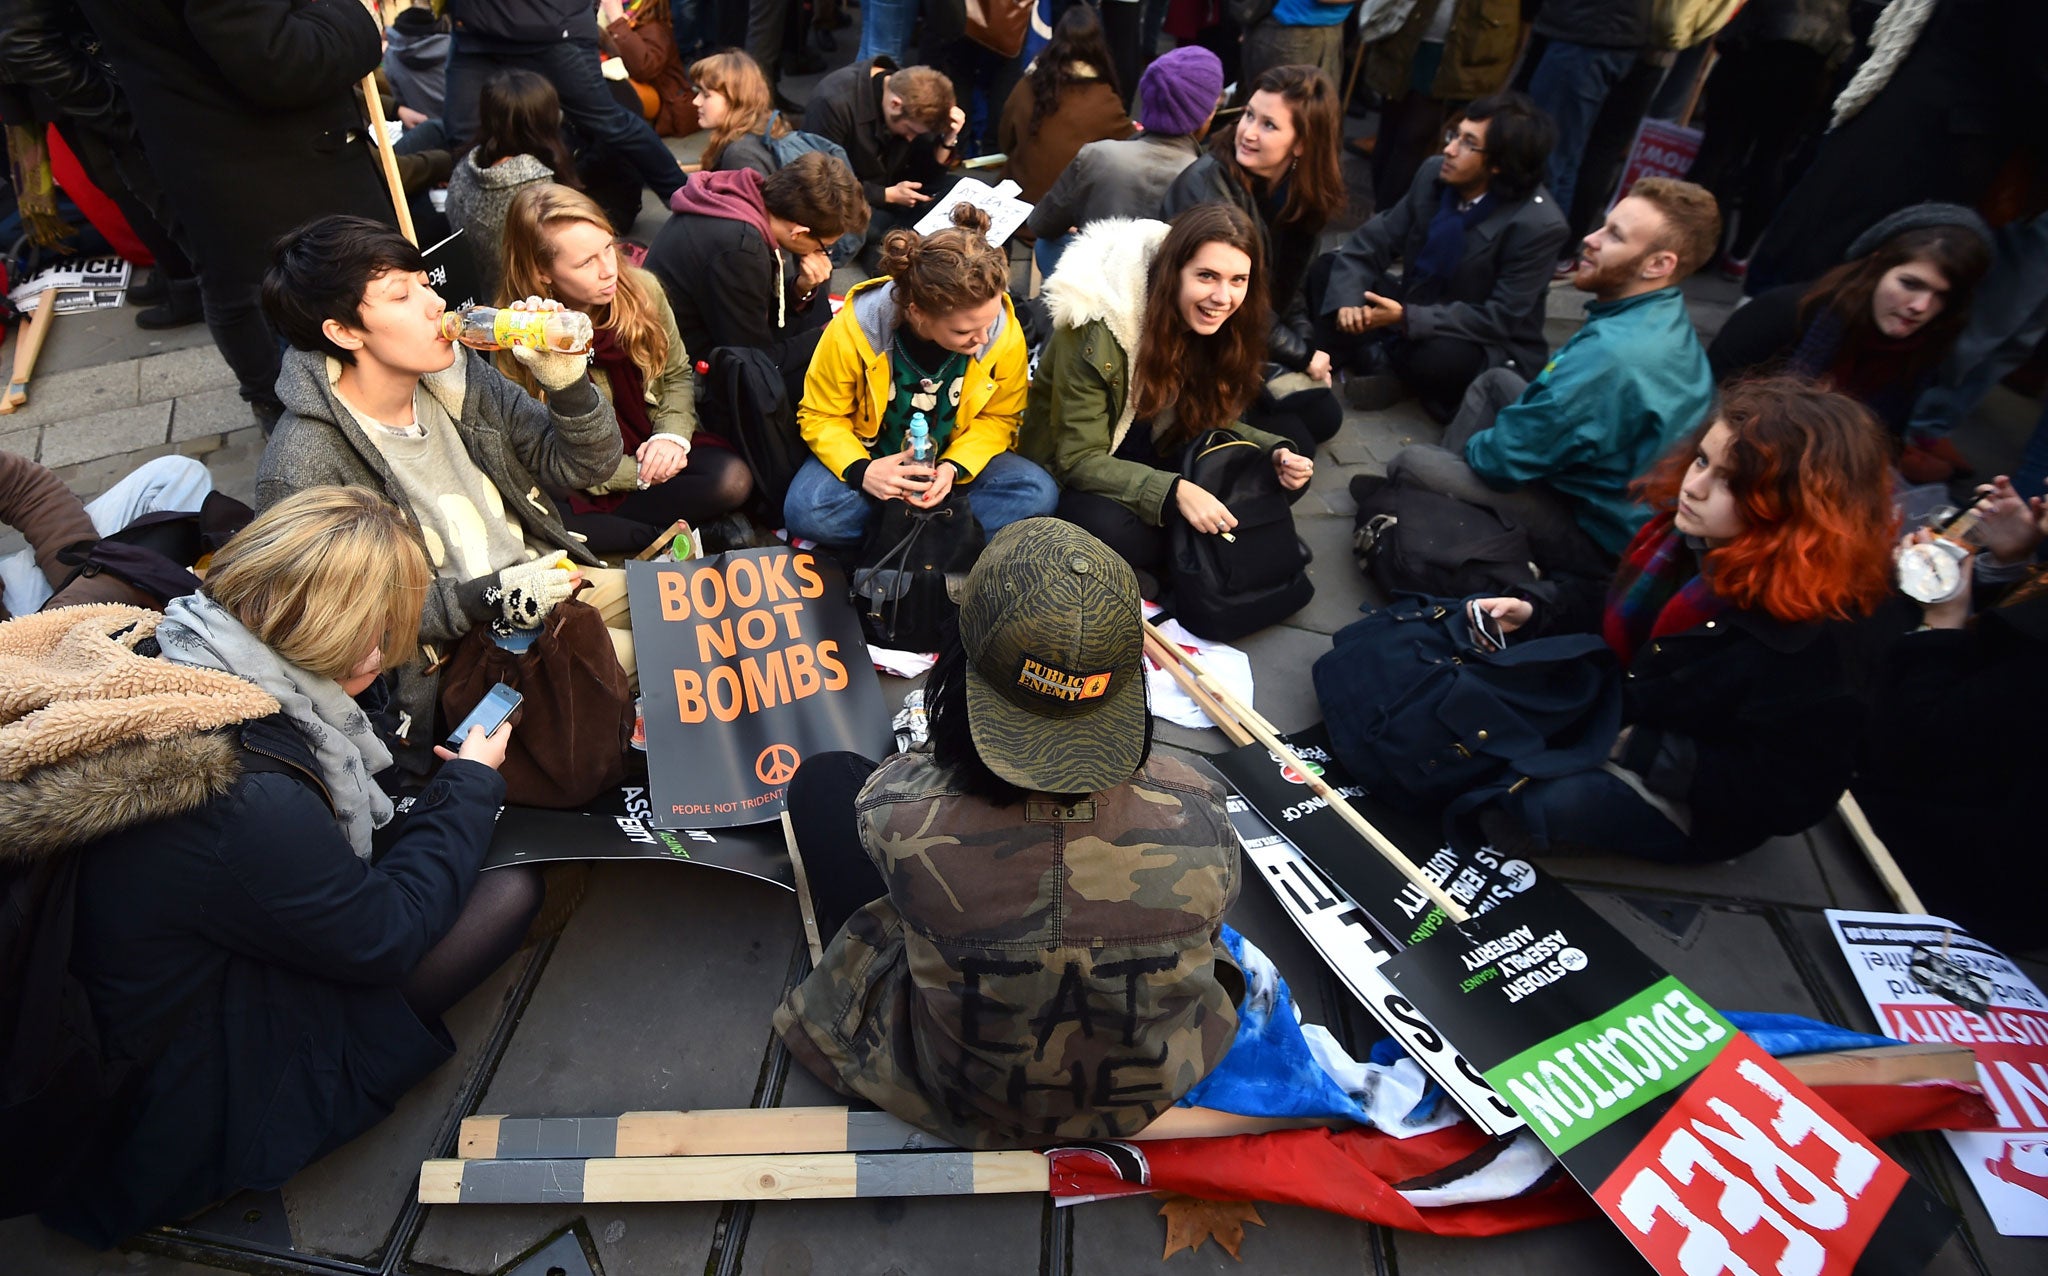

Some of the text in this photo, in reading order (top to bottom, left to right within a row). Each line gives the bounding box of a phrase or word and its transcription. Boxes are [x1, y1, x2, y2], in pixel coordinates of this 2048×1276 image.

[657, 553, 825, 622] BOOKS
[695, 602, 804, 663] NOT
[673, 640, 849, 724] BOMBS
[1018, 672, 1080, 701] ENEMY
[1023, 658, 1086, 689] PUBLIC
[672, 788, 784, 815] PEOPLE NOT TRIDENT
[1281, 807, 1302, 822] OF
[615, 817, 658, 845] ERITY
[658, 831, 691, 859] AGAINST
[1459, 929, 1569, 994] ASSEMBLY AGAINST
[1460, 924, 1535, 972] AUSTERITY
[1501, 951, 1585, 1004] THE STUDENT
[956, 951, 1182, 1062] EAT
[1506, 989, 1727, 1138] EDUCATION
[1617, 1058, 1881, 1276] FREE
